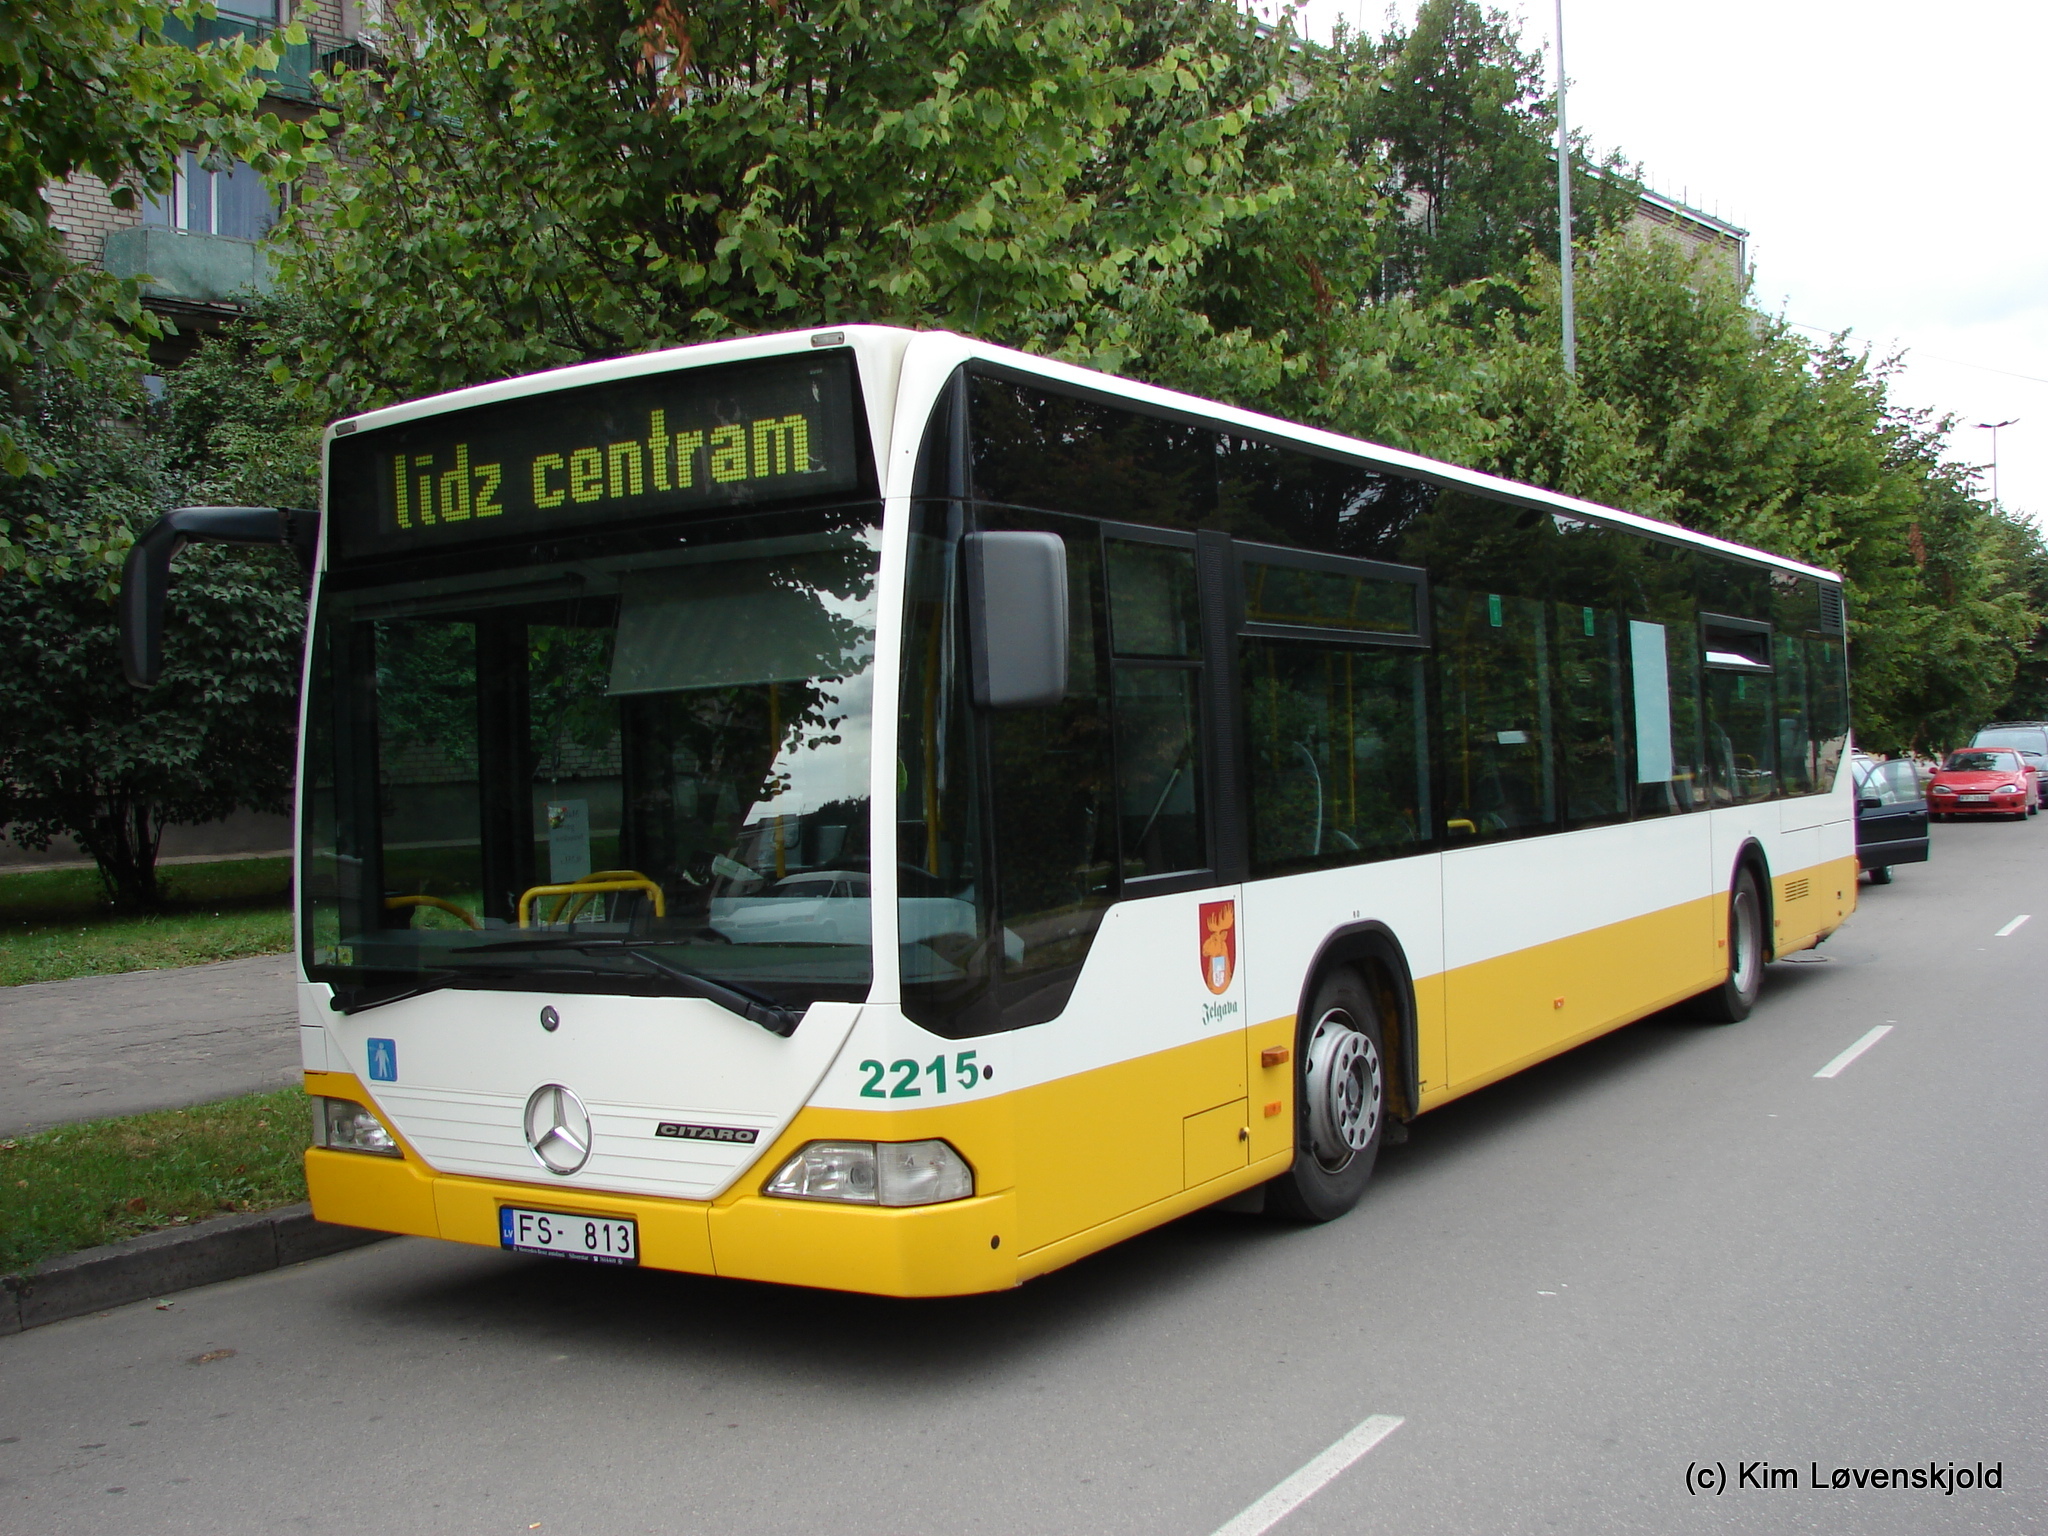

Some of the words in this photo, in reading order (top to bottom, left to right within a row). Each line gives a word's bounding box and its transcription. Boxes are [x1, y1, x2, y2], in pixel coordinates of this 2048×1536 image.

[395, 444, 502, 528] līdz
[532, 409, 809, 508] centram
[1202, 1001, 1238, 1025] Jelgava
[859, 1050, 979, 1099] 2215
[660, 1124, 754, 1141] CITARO
[504, 1229, 514, 1238] LV
[584, 1221, 630, 1253] 813
